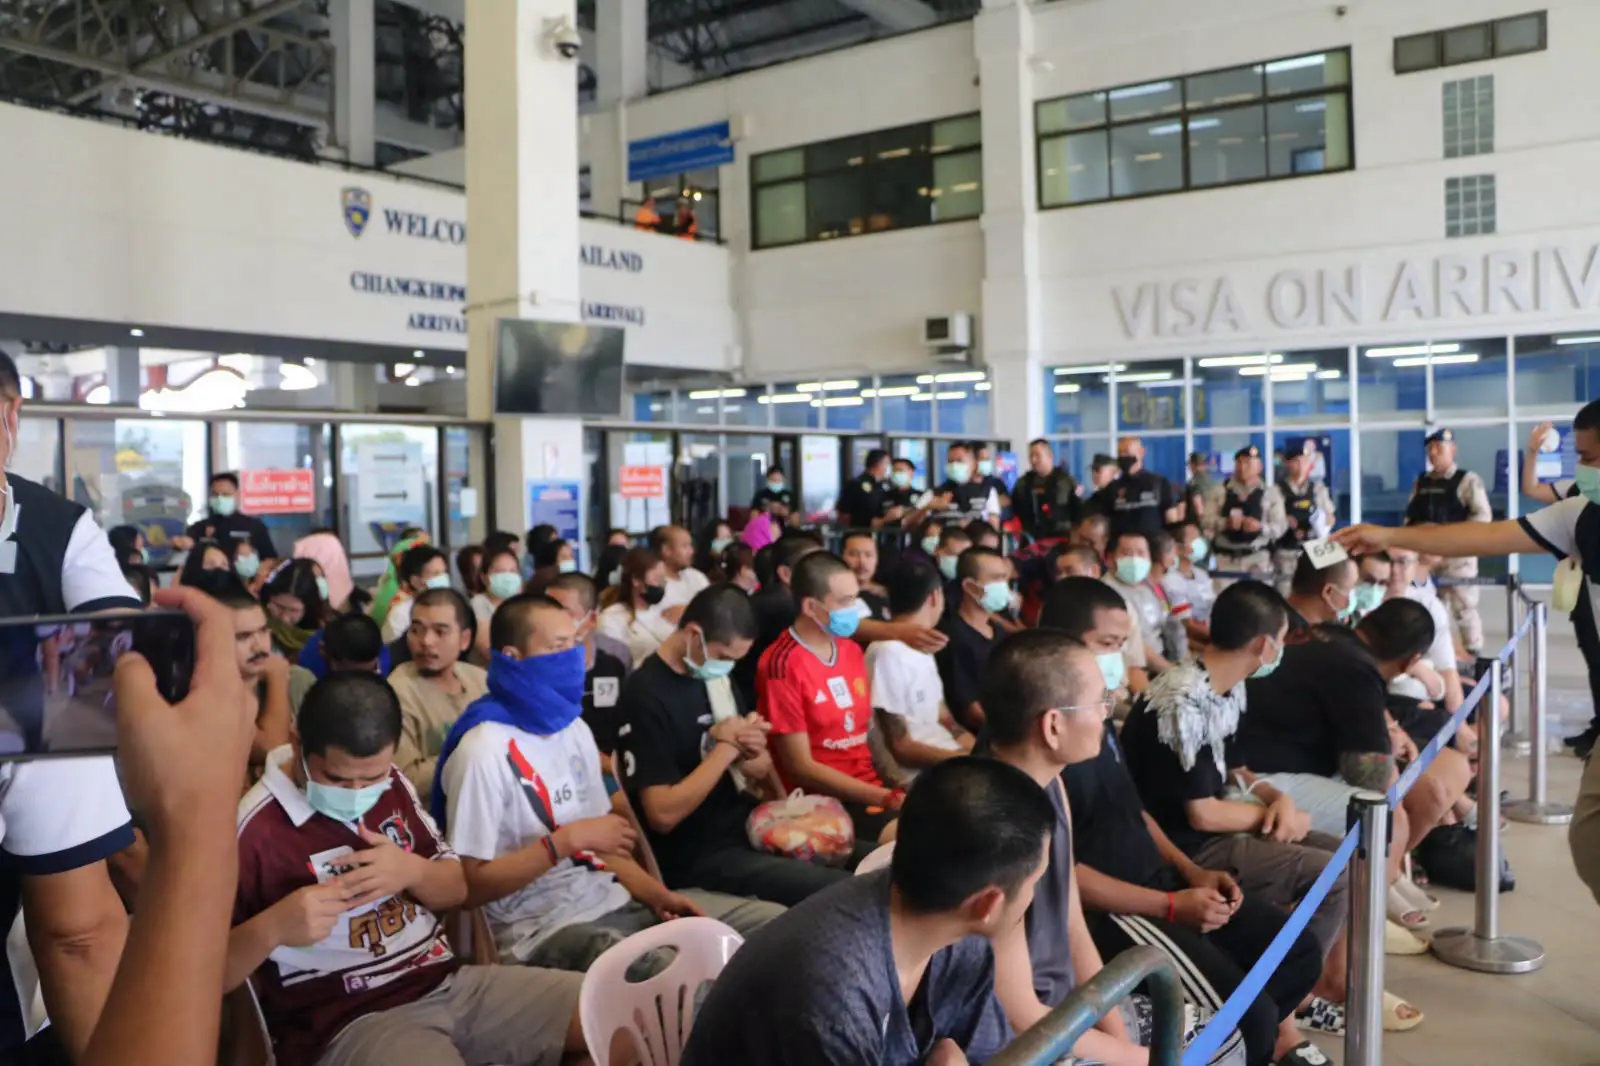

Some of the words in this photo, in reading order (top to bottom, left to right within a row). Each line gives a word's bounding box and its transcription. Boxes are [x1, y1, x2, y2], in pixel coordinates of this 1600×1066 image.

[1110, 276, 1249, 340] VISA
[1266, 263, 1362, 330] ON
[1382, 245, 1600, 323] ARRIV
[1313, 541, 1336, 558] 69
[597, 682, 614, 697] 57
[554, 782, 573, 806] 46
